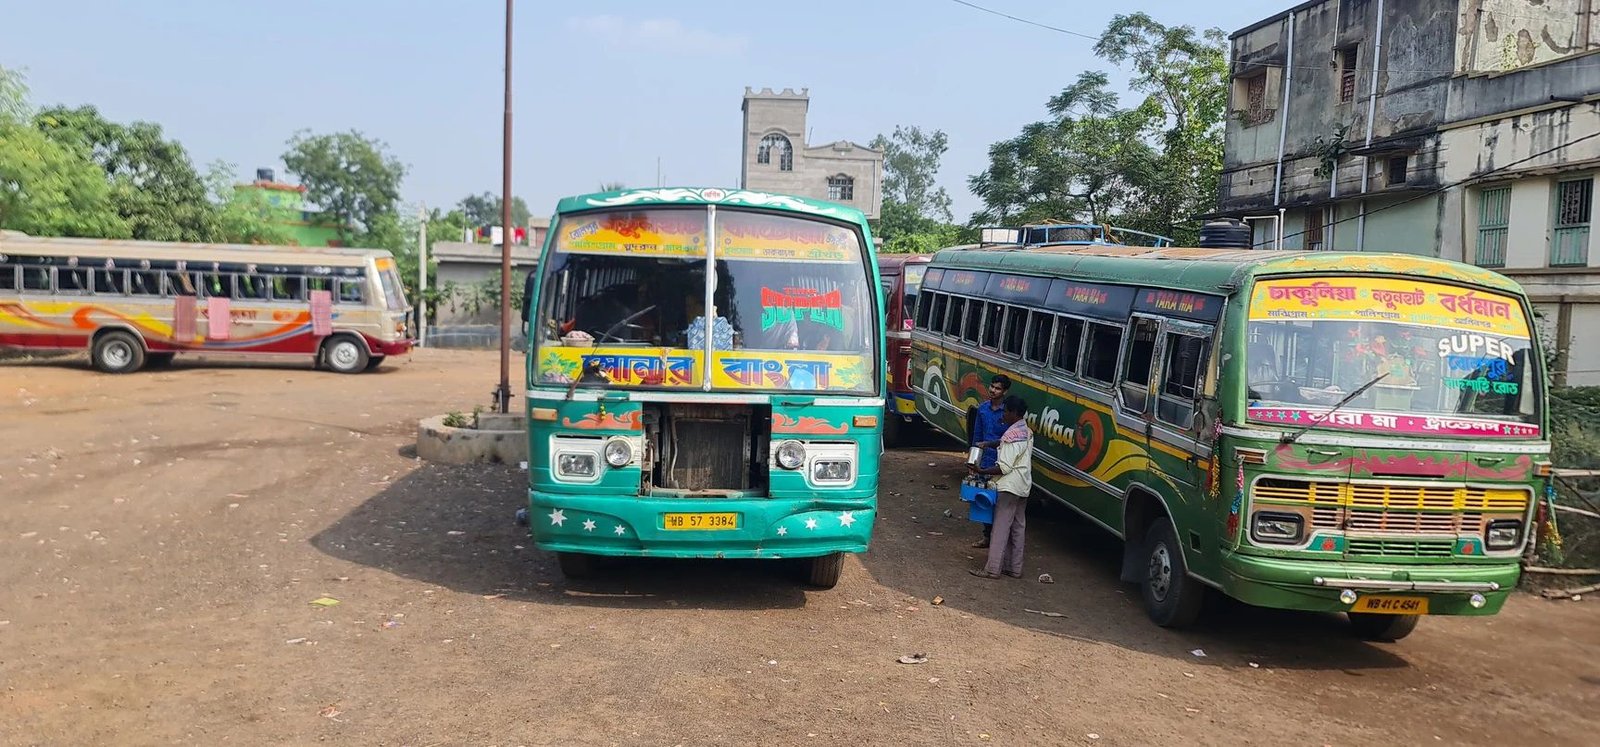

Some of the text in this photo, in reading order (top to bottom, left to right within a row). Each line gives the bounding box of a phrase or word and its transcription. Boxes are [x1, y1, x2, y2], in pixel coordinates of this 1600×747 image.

[760, 286, 844, 331] SUPER
[1268, 282, 1357, 307] চাকুলিয়া
[1371, 288, 1425, 311] নতুনহাট
[1438, 291, 1511, 320] বর্ধমান
[1438, 334, 1515, 365] SUPER
[1492, 381, 1519, 395] রোড
[1038, 405, 1075, 448] Maa
[1369, 414, 1399, 428] মা
[690, 515, 703, 526] 57
[708, 515, 734, 526] 3384
